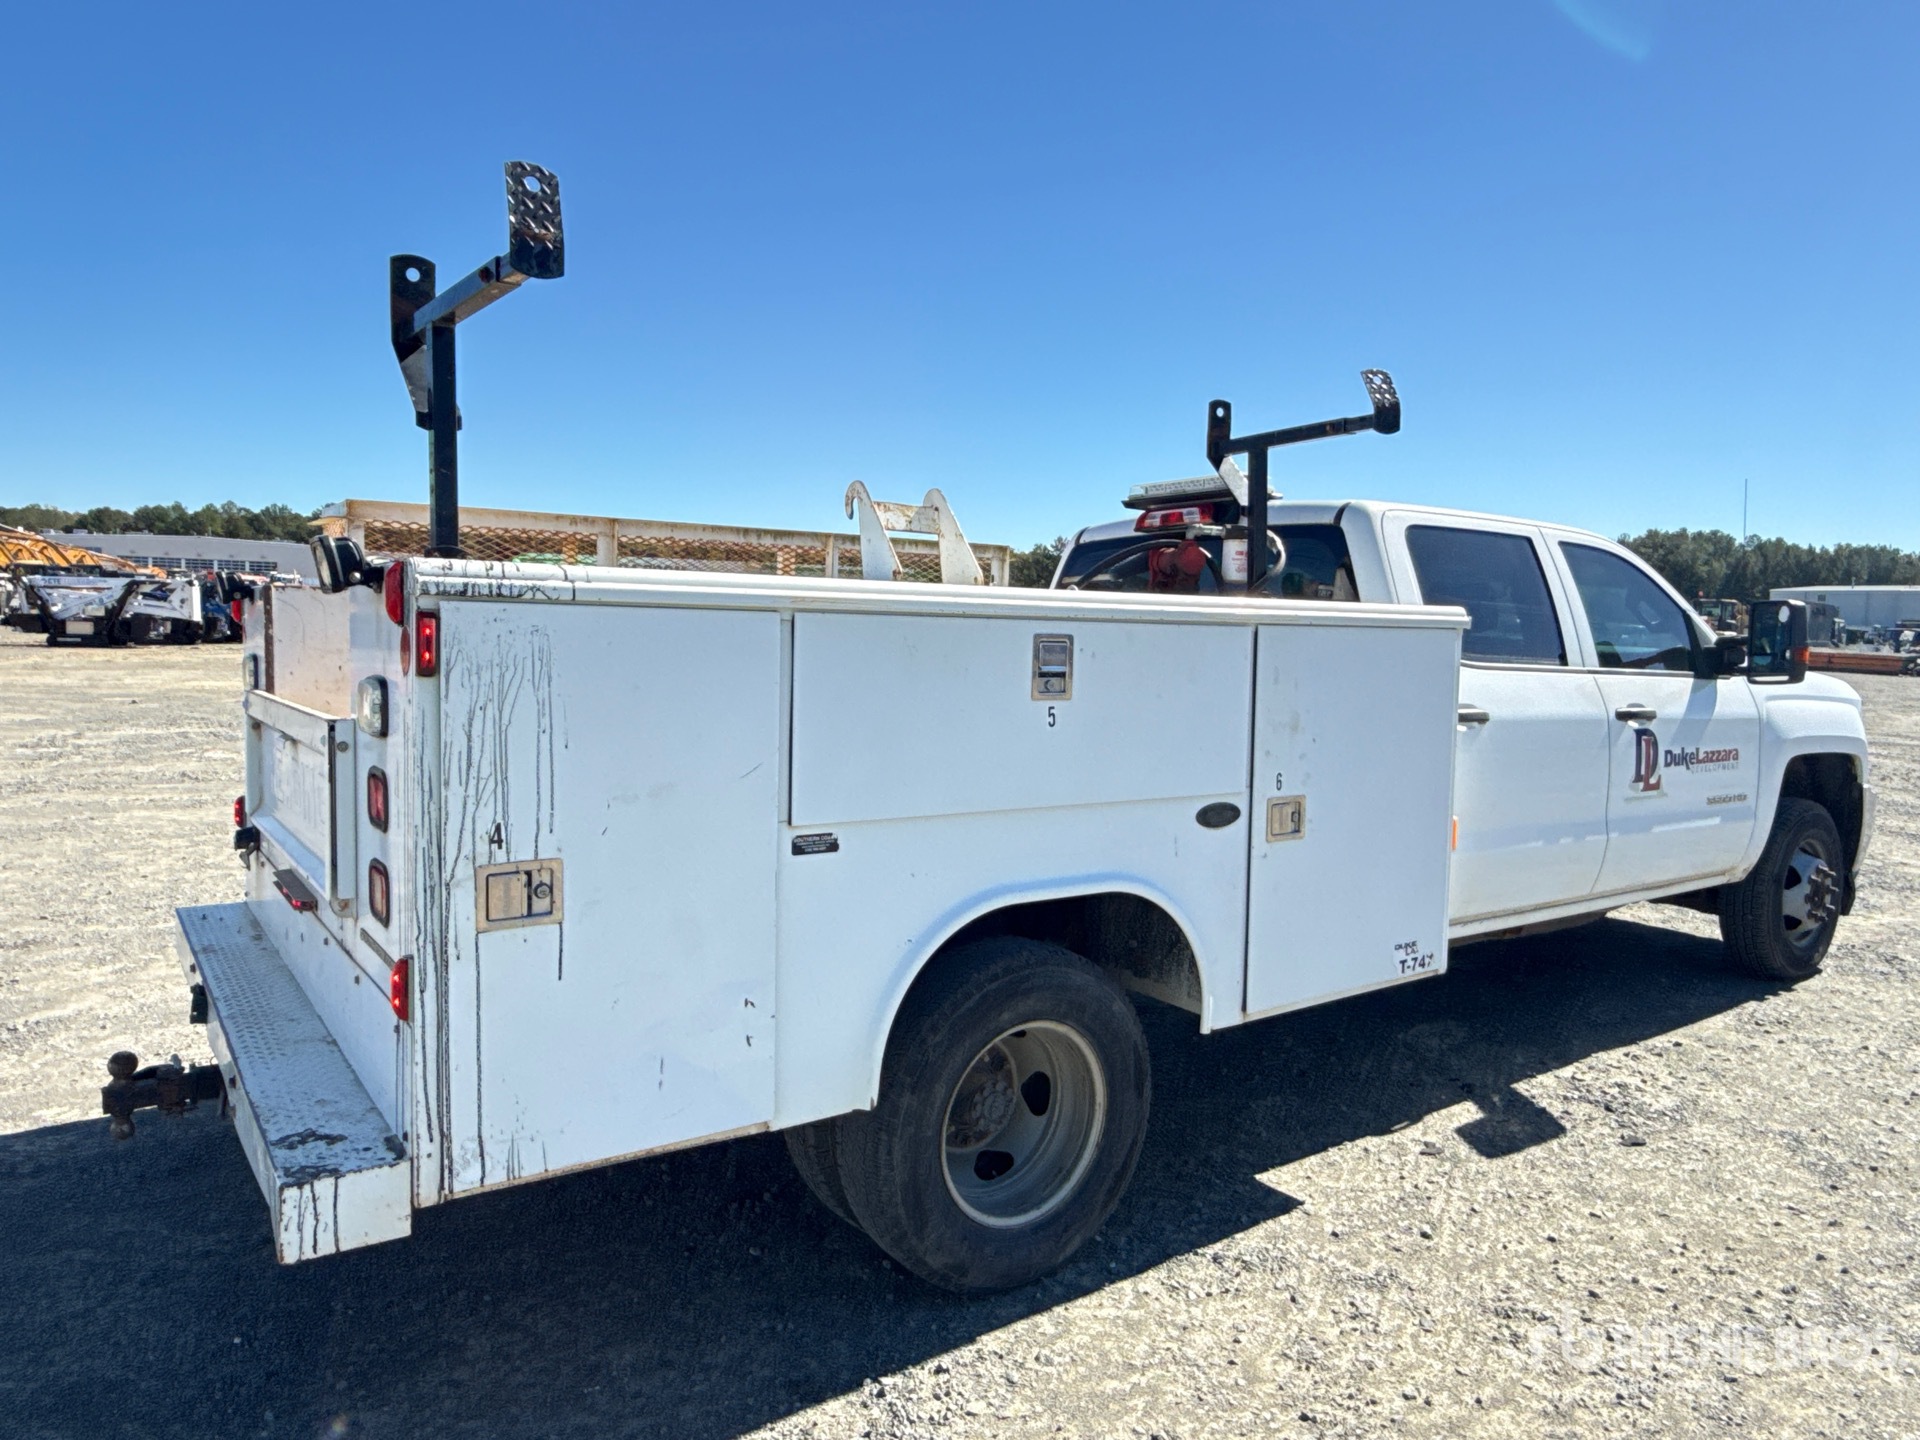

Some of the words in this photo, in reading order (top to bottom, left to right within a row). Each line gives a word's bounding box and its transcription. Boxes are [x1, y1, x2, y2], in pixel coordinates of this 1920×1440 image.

[1047, 705, 1056, 728] 5
[1663, 747, 1739, 771] DukeLazzara
[1691, 762, 1739, 774] DEVELOPMENT
[1276, 772, 1283, 791] 6
[489, 822, 504, 850] 4
[1394, 940, 1417, 951] DUKE
